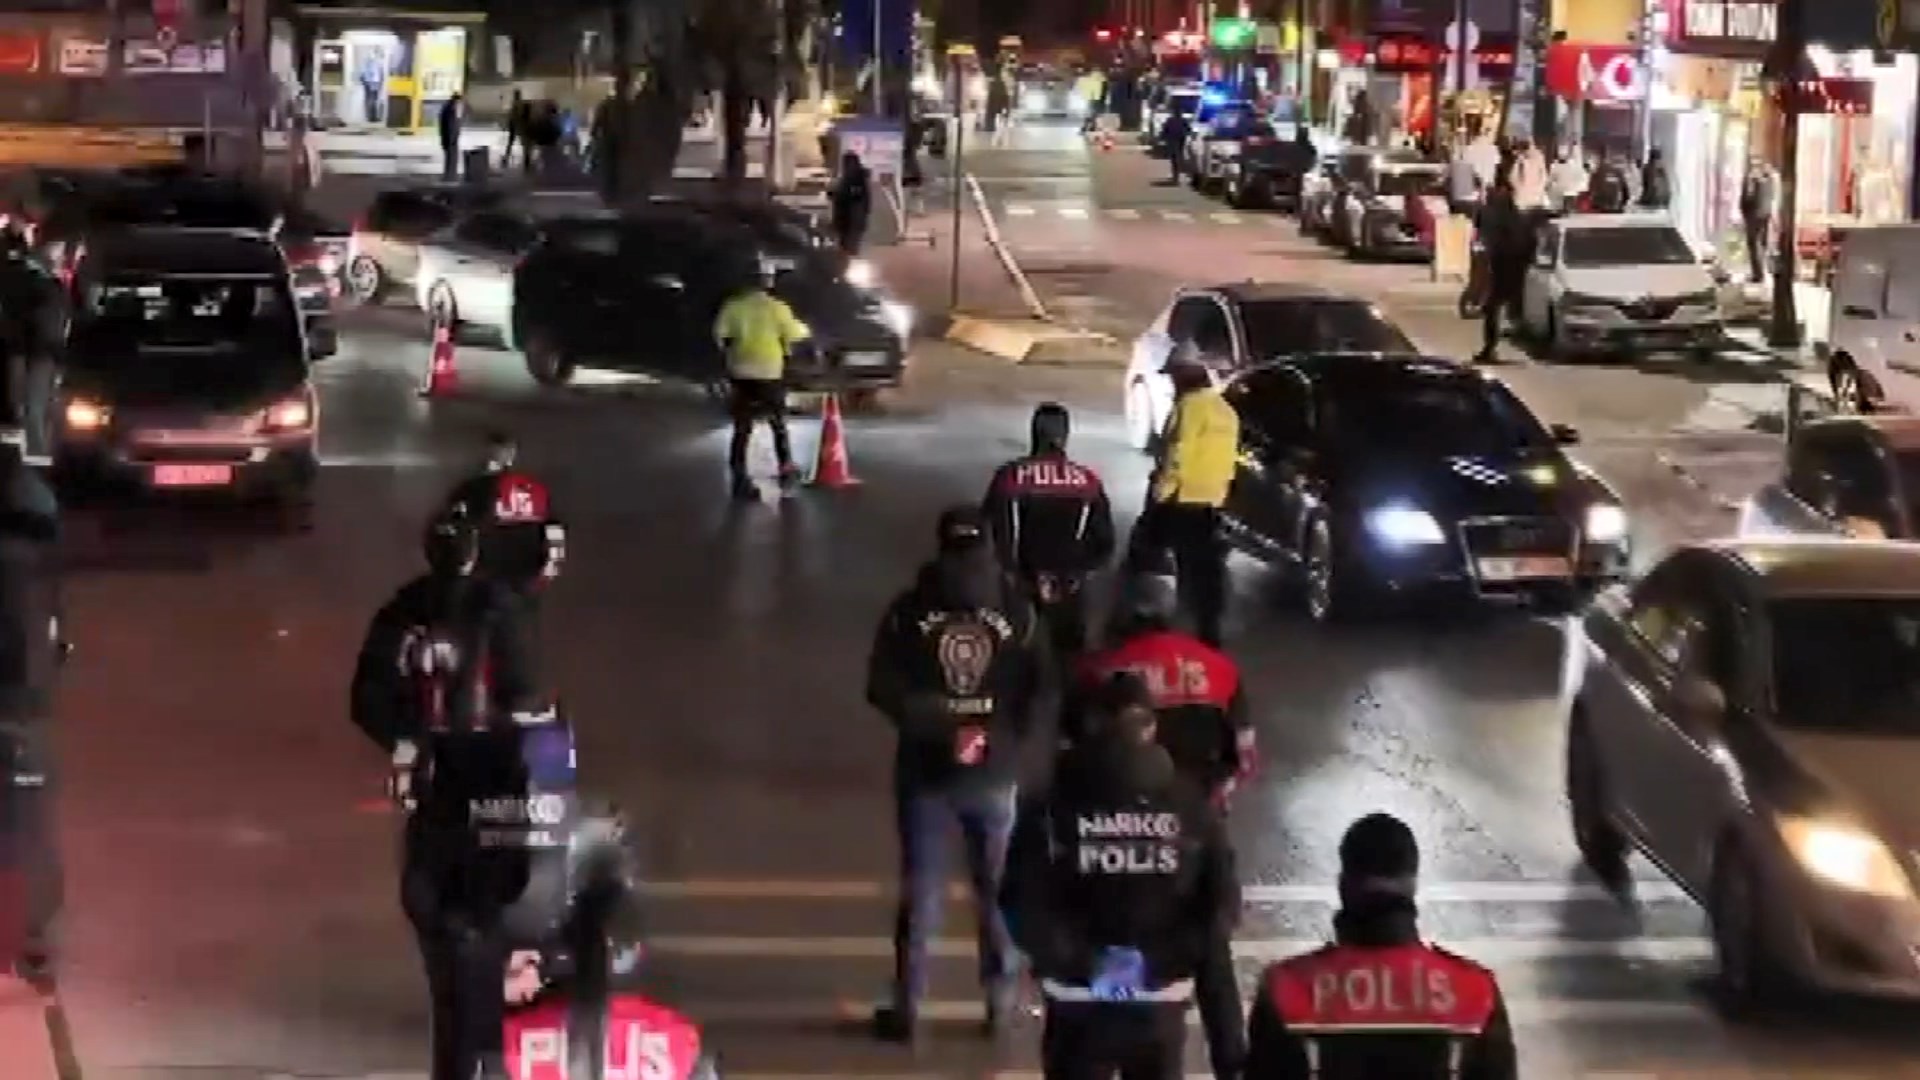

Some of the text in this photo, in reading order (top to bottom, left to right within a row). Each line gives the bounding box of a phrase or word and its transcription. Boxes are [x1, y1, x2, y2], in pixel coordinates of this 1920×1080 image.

[1079, 844, 1179, 874] POLİS
[1313, 959, 1458, 1014] POLİS
[519, 1020, 676, 1080] PLİS
